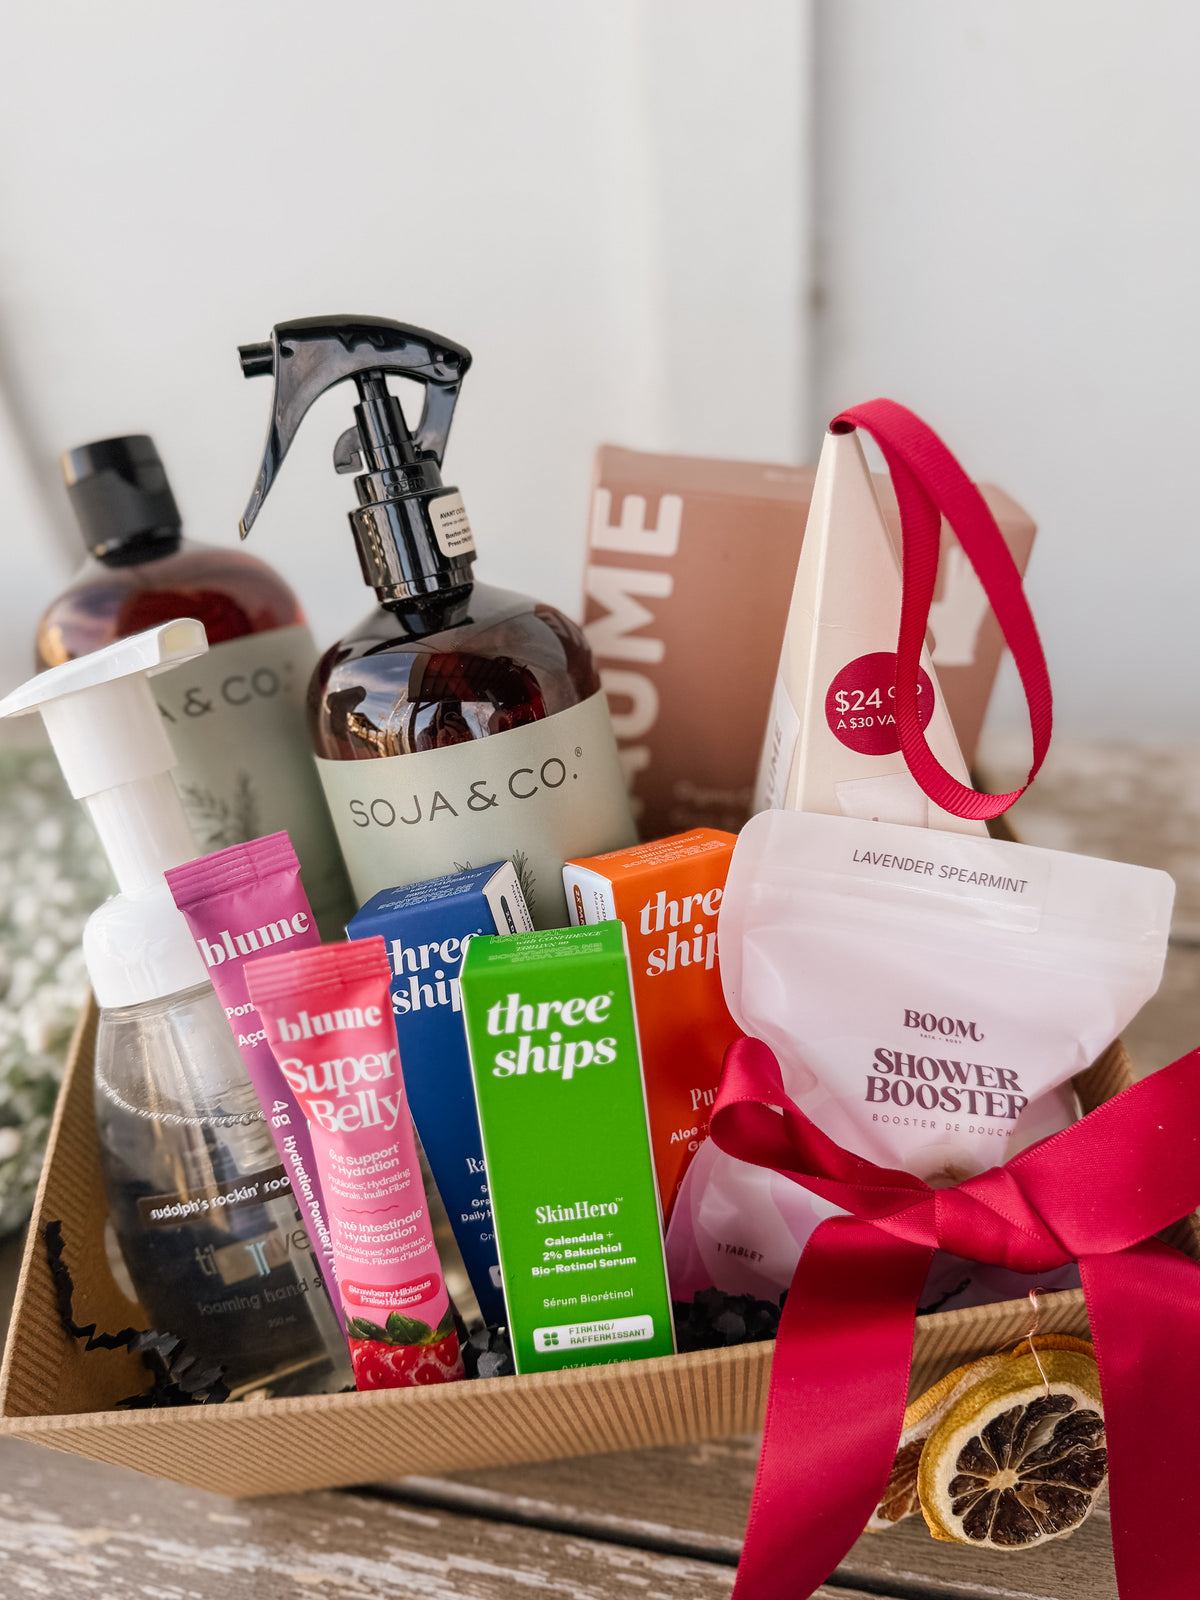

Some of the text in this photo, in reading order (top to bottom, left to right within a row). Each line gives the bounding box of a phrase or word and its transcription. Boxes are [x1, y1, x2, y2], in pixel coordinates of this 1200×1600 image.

[183, 687, 214, 718] &
[834, 687, 883, 716] $24
[837, 719, 847, 730] A
[849, 716, 874, 730] $30
[349, 790, 459, 828] SOJA
[467, 780, 499, 812] &
[852, 848, 1028, 894] LAVENDER SPEARMINT
[639, 887, 724, 936] thre
[197, 911, 311, 968] blume
[646, 923, 719, 977] ship
[277, 1005, 383, 1043] blume
[487, 993, 612, 1036] three
[903, 1008, 985, 1042] BOOM
[238, 1029, 267, 1048] Aça
[492, 1031, 618, 1080] ships
[280, 1048, 398, 1099] Super
[872, 1047, 1024, 1092] SHOWER
[864, 1075, 1029, 1119] BOOSTER
[306, 1087, 403, 1134] Belly
[670, 1127, 698, 1144] Aloe
[872, 1113, 1015, 1137] BOOSTER DE DOUCH
[329, 1143, 399, 1167] Gut Support
[465, 1156, 487, 1174] Ra
[272, 1100, 291, 1129] 4g
[283, 1135, 314, 1201] Hydration
[307, 1200, 332, 1246] Powder
[338, 1157, 400, 1179] Hydration
[367, 1168, 411, 1190] Hydrating
[150, 1176, 290, 1220] rudolph's rockin' roo
[364, 1188, 389, 1200] Inulin
[389, 1179, 411, 1194] Fibre
[359, 1208, 423, 1233] Intestinale
[461, 1210, 486, 1222] Daily
[345, 1224, 417, 1244] Hydratation
[386, 1235, 427, 1256] Minéraux
[544, 1231, 614, 1248] Calendula +
[372, 1256, 400, 1266] Fibres
[542, 1243, 622, 1262] 2% Bakuchiol
[725, 1244, 764, 1262] TABLET
[531, 1255, 637, 1277] Bio-Retinol Serum
[264, 1277, 309, 1303] hand
[348, 1279, 432, 1298] Strawberry Hibiscus
[361, 1293, 422, 1306] Fraise Hibiscus
[543, 1288, 634, 1308] Sérum Biorétinol
[569, 1322, 615, 1335] FIRMING/
[570, 1328, 646, 1345] RAFFERMISSANT
